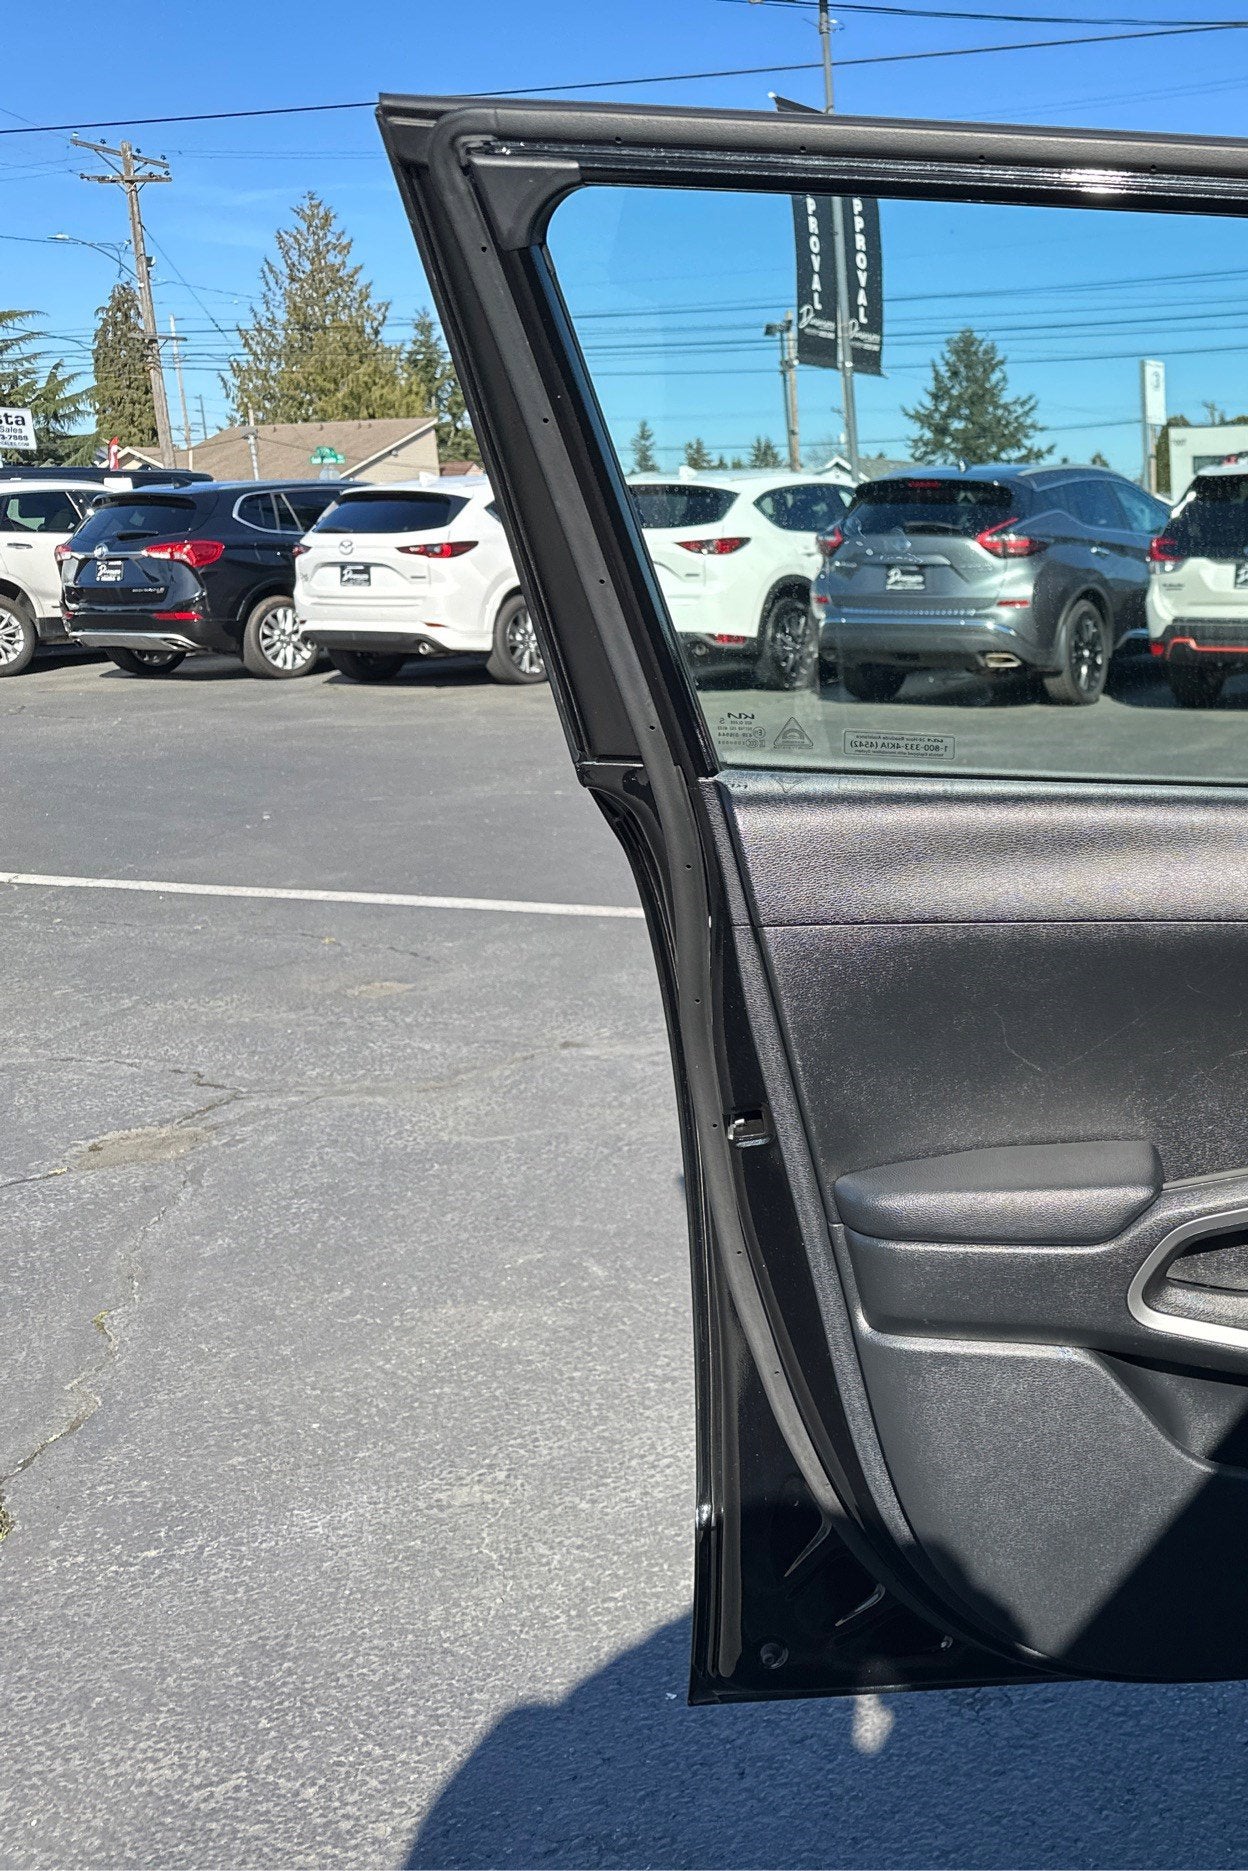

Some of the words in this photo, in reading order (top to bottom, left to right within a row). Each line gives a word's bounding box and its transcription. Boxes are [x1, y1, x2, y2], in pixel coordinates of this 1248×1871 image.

[806, 194, 823, 310] PROVAL
[851, 197, 868, 324] PPROVAL
[0, 412, 26, 426] ta
